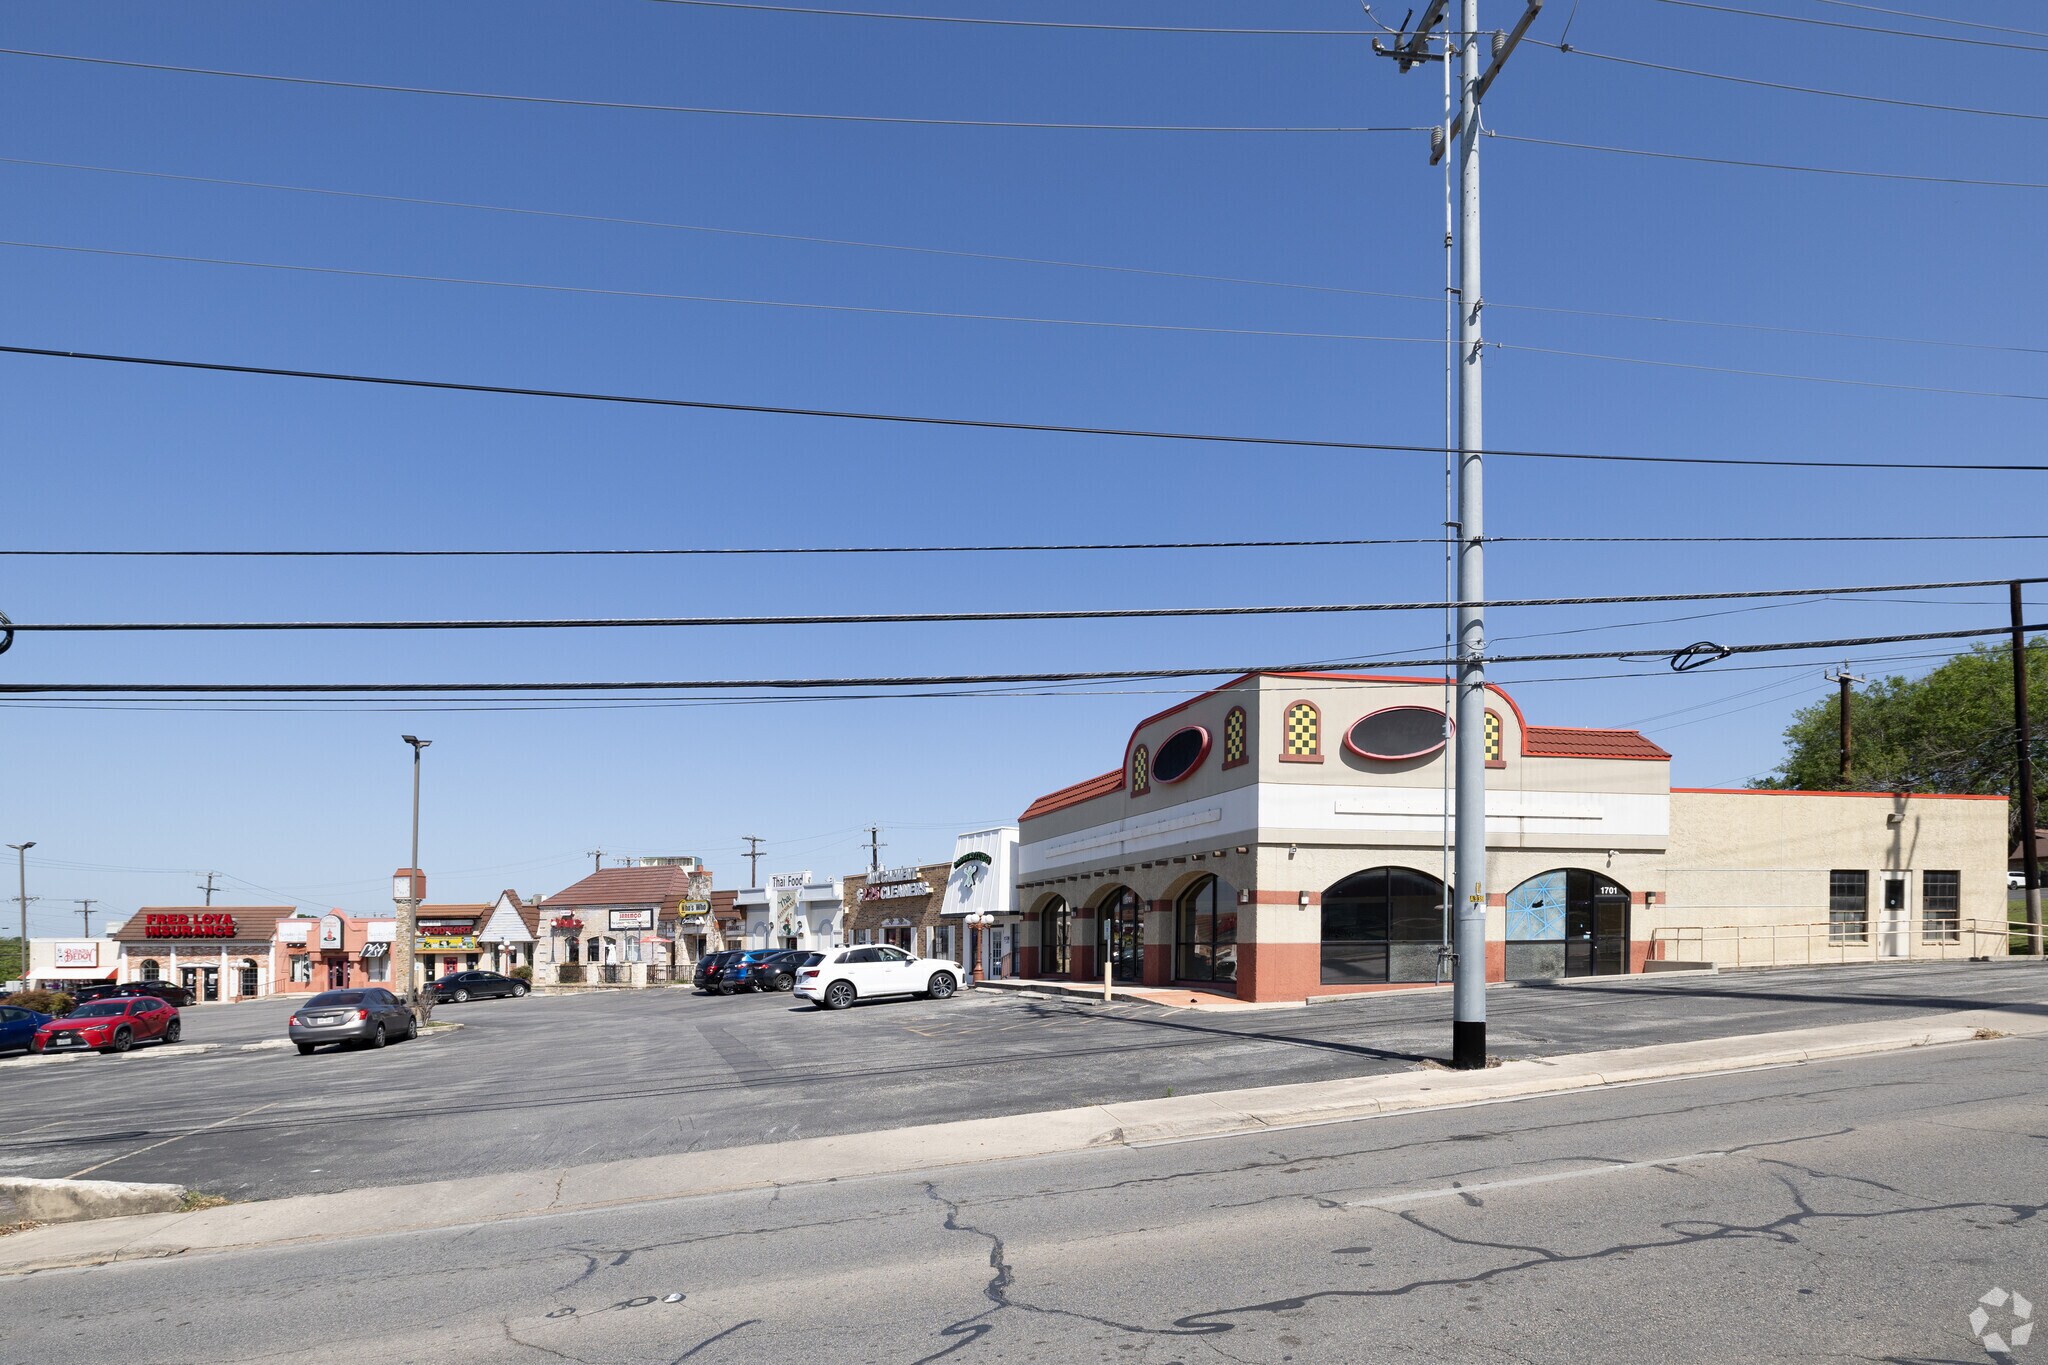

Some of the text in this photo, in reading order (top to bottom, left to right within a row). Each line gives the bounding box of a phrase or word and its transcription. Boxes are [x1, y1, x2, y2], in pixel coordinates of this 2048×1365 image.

[772, 873, 803, 887] Thai Food
[880, 882, 929, 900] CLEANERS
[1600, 887, 1618, 895] 1701
[146, 914, 233, 925] FRED LOYA
[145, 926, 234, 937] INSURANCE
